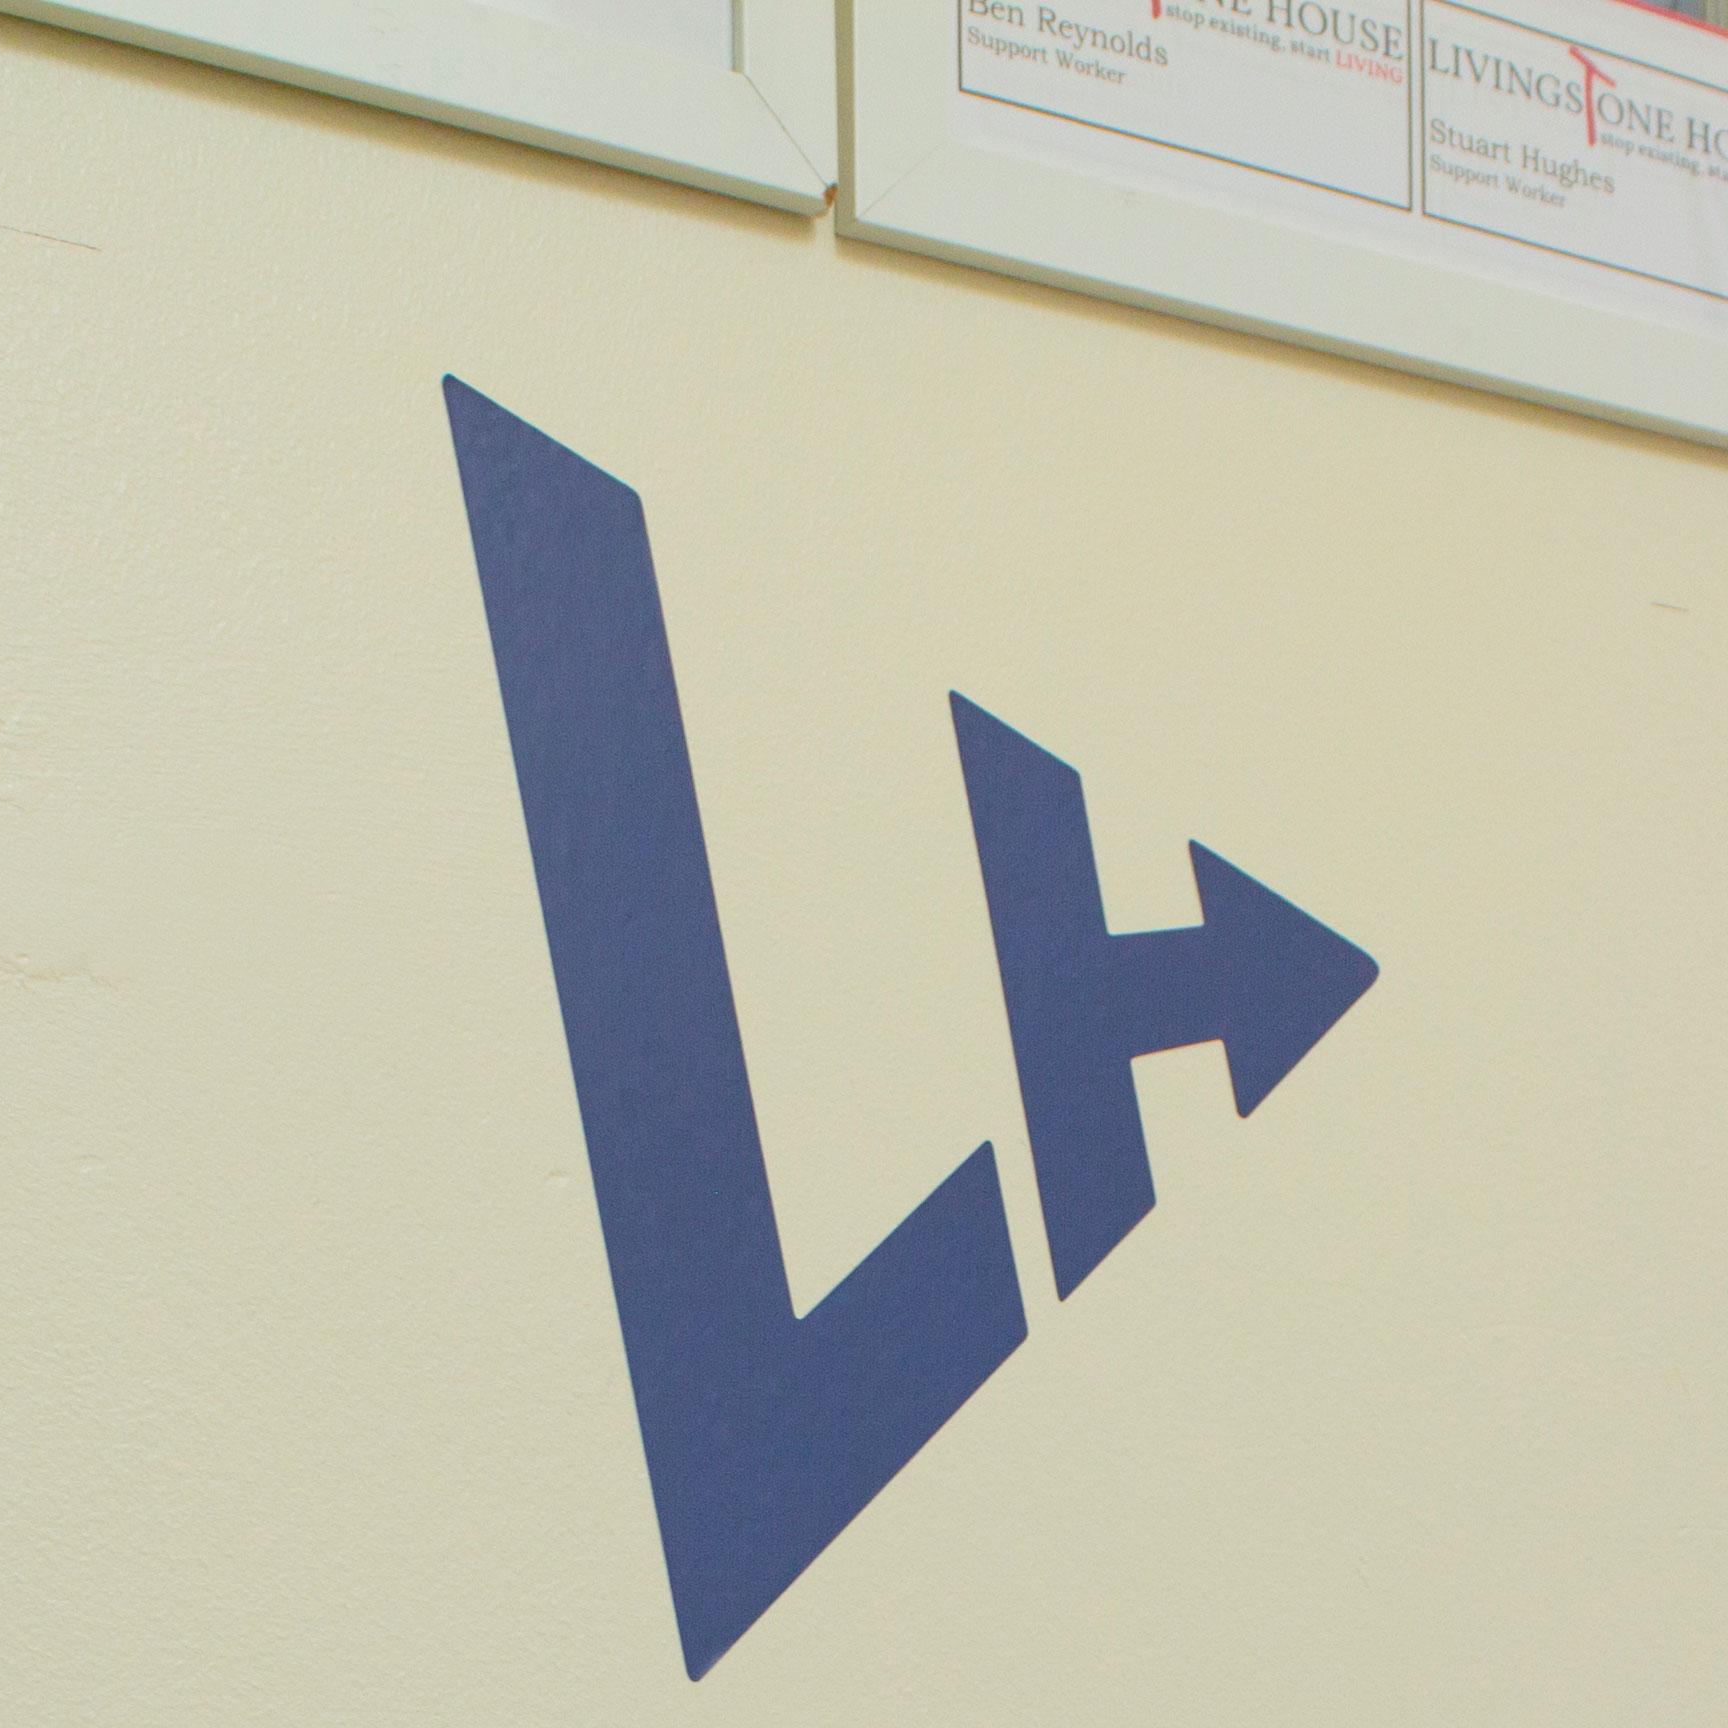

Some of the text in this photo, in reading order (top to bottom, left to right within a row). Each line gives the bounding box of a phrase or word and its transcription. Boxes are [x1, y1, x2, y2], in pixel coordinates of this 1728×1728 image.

[967, 25, 1128, 86] Support Worker
[1037, 5, 1169, 67] Reynolds
[1165, 4, 1205, 29] stop
[1208, 15, 1286, 52] existing,
[1290, 38, 1330, 63] start
[1335, 49, 1404, 85] LIVING
[1266, 0, 1404, 61] HOUSE
[1428, 38, 1674, 147] LIVINGSTONE
[1429, 117, 1616, 195] Stuart Hughes
[1599, 131, 1634, 157] stop
[1429, 152, 1567, 209] Support Worker
